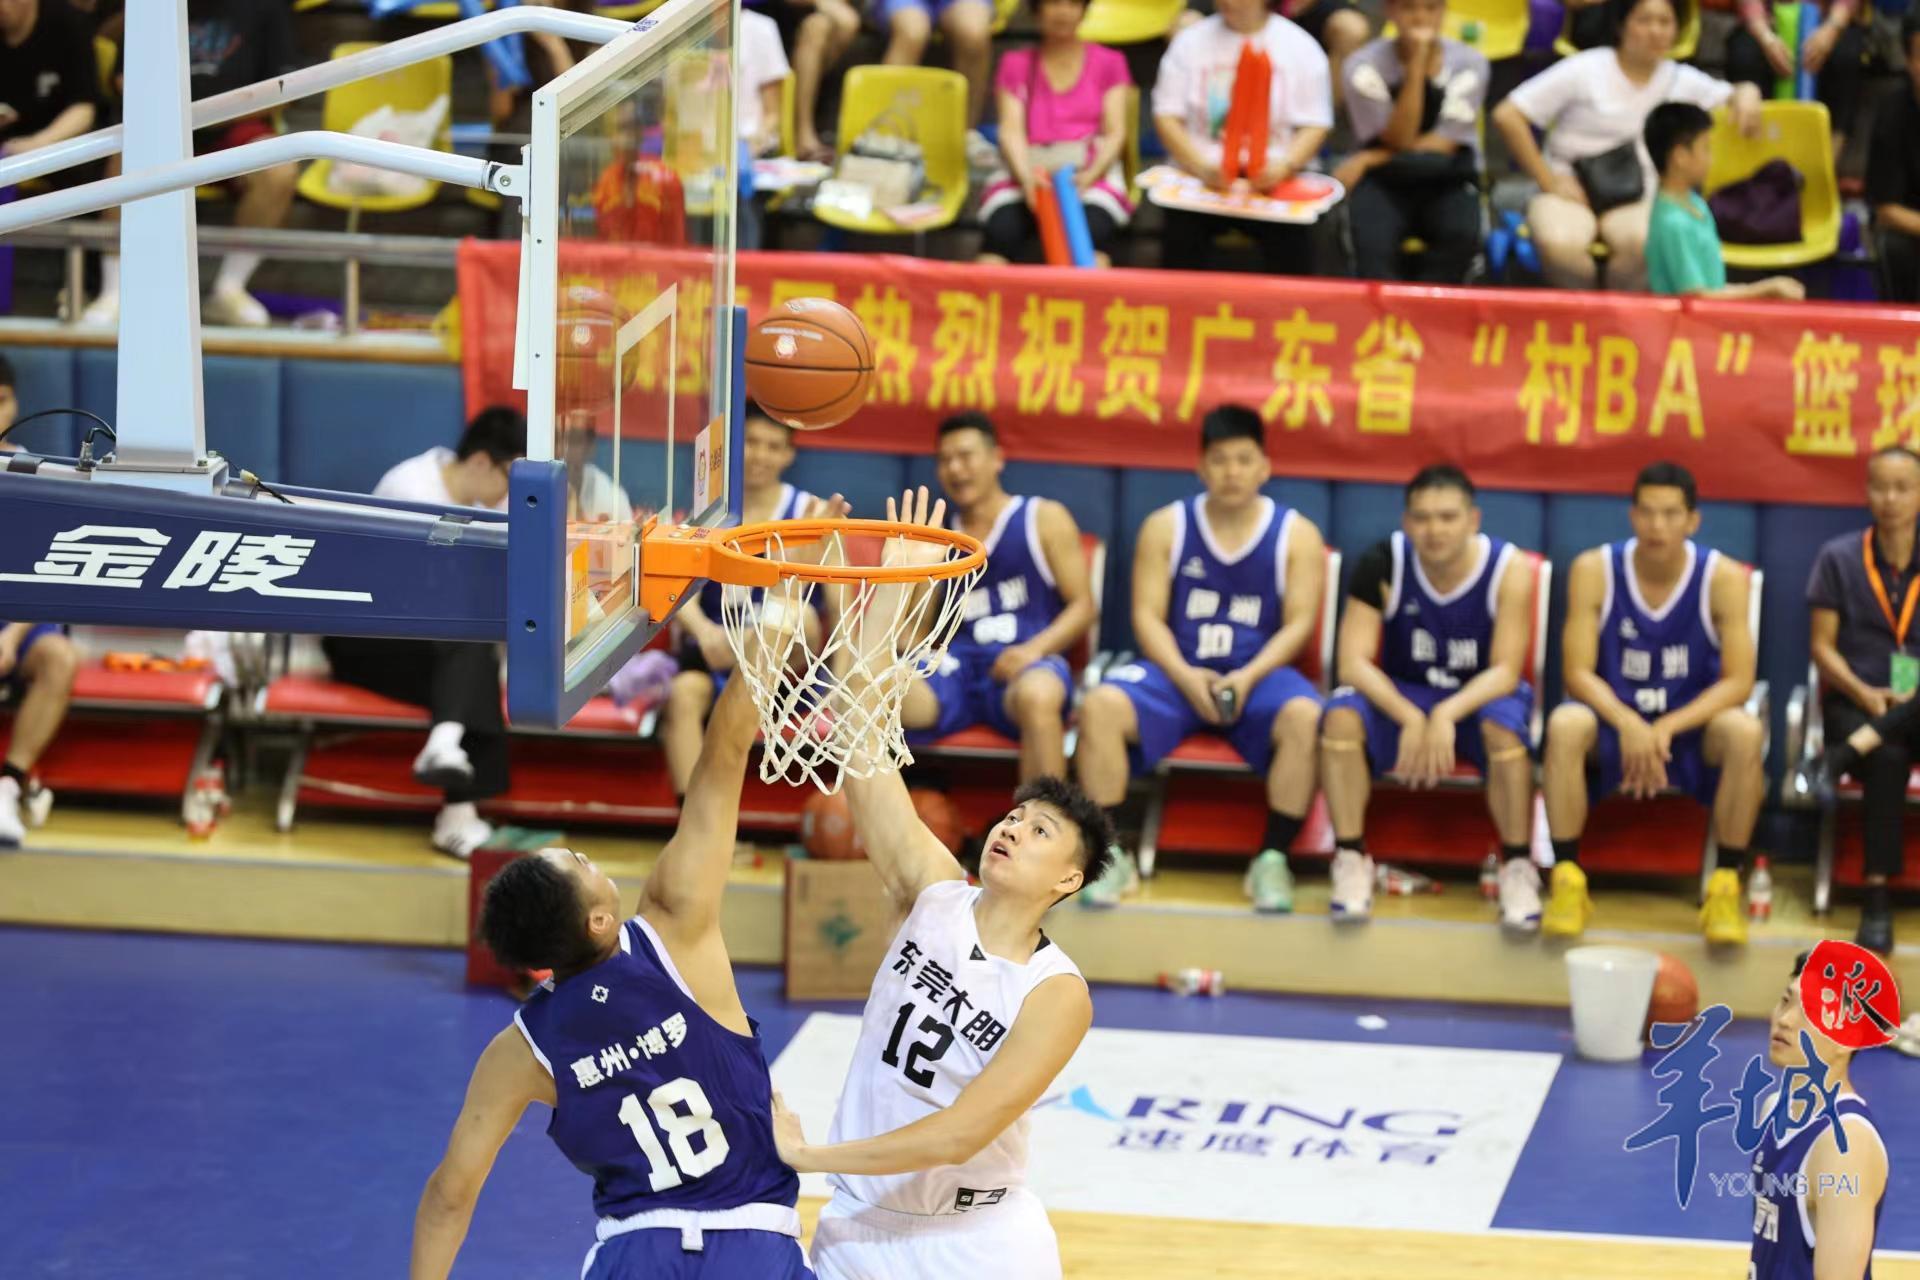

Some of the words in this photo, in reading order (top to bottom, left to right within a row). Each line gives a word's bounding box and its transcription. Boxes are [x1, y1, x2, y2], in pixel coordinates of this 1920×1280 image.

[0, 525, 372, 602] 金陵
[892, 939, 1007, 1052] 东莞大朗
[570, 1011, 688, 1089] 惠州·博罗
[881, 1002, 955, 1089] 12
[617, 1076, 731, 1193] 18
